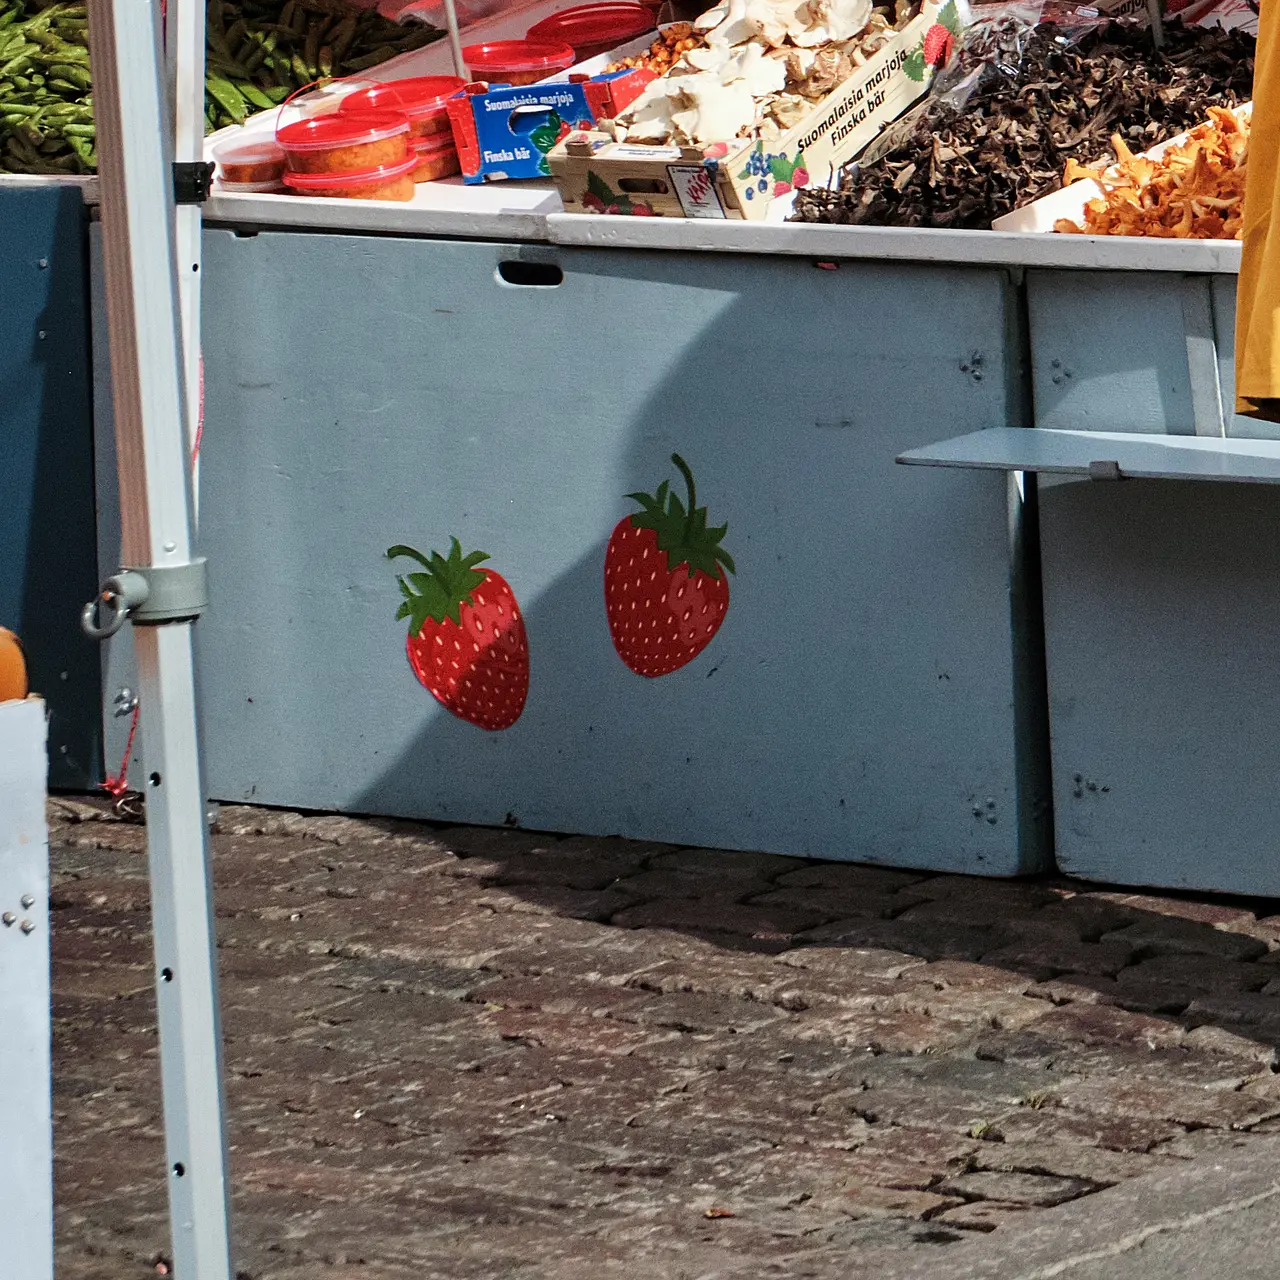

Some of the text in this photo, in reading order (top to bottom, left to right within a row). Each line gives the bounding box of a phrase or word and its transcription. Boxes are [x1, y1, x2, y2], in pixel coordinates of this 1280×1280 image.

[539, 90, 574, 108] marjoja
[797, 48, 908, 154] Suomalaisia marjoja
[830, 89, 886, 147] Finska bär
[483, 144, 531, 164] Finska bär
